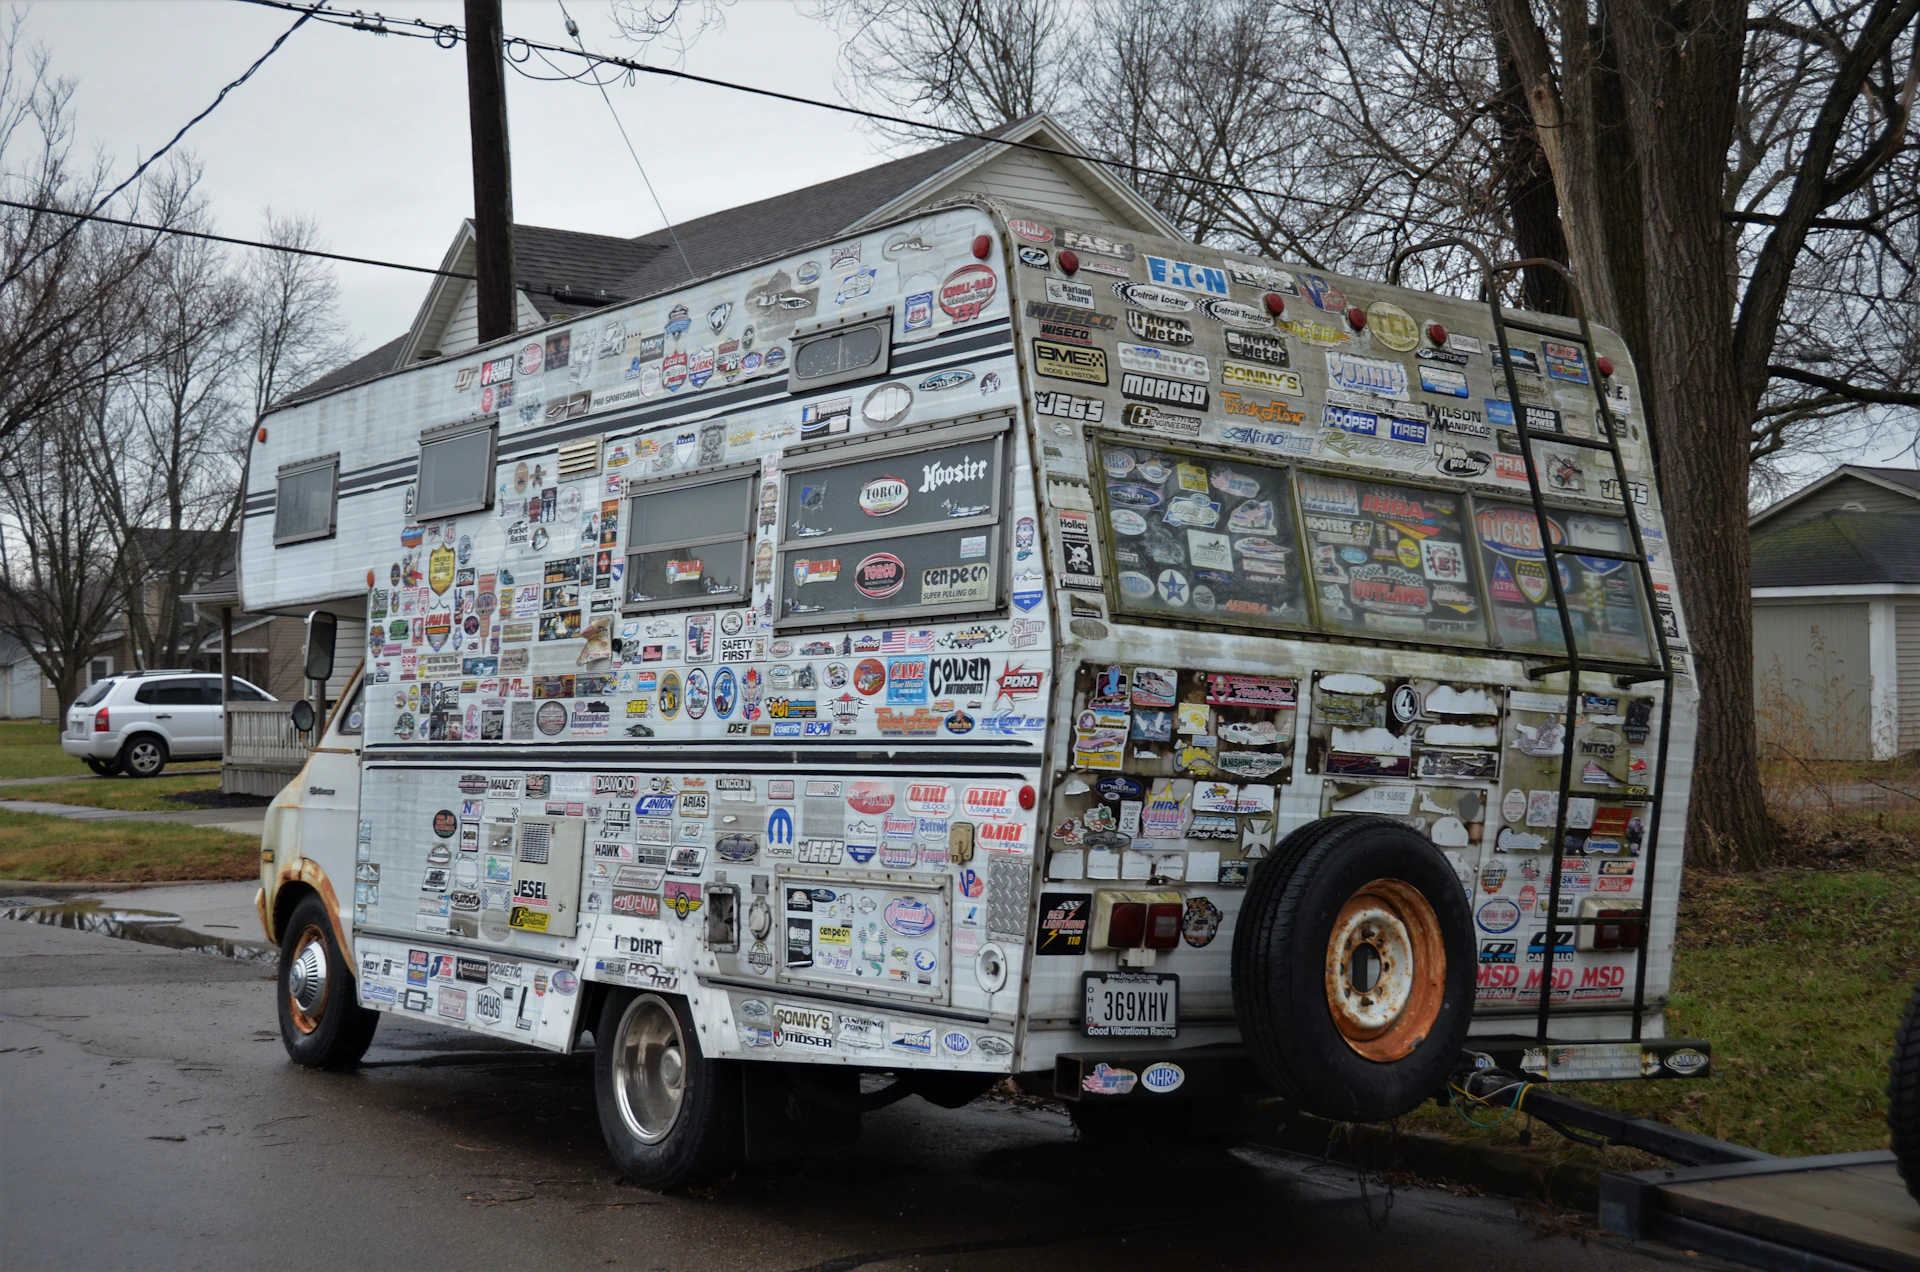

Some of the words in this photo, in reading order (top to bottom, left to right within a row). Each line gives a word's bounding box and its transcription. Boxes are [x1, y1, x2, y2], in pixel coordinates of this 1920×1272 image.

[1064, 230, 1124, 254] FAST
[1150, 257, 1228, 295] EATON
[943, 277, 994, 298] KNOLL-GAS
[1062, 284, 1092, 297] Harland
[1297, 274, 1330, 310] VP
[1066, 293, 1089, 304] Sharp
[1131, 289, 1158, 302] Detroit
[1161, 294, 1188, 307] Locker
[1031, 303, 1114, 330] WISECO
[1147, 313, 1184, 330] Auto
[1214, 305, 1239, 318] Detroit
[1241, 311, 1271, 324] Truetrac
[1042, 324, 1089, 339] WISECO
[1145, 326, 1192, 342] Meter
[1243, 334, 1278, 349] Auto
[1037, 345, 1091, 366] BME
[1243, 344, 1287, 363] Meter
[1433, 352, 1467, 364] PISTONS
[491, 358, 512, 370] SEALED
[1546, 356, 1562, 365] Blue
[1564, 359, 1584, 368] Blood
[489, 369, 511, 383] POWER
[1044, 367, 1063, 375] RODS
[1071, 371, 1100, 380] PISTONS
[1224, 366, 1298, 389] SONNY'S
[593, 396, 604, 407] PRO
[605, 387, 640, 405] SPORTSMAN
[1123, 374, 1207, 405] MOROSO
[1343, 383, 1363, 391] RACING
[1366, 387, 1397, 396] EQUIPMENT
[1038, 393, 1103, 421] JEG'S
[1220, 390, 1263, 423] Trick
[1261, 401, 1305, 425] Flow
[1385, 408, 1406, 417] RACING
[1424, 403, 1481, 423] WILSON
[1526, 408, 1555, 419] SEALED
[1149, 418, 1198, 432] ENGINEERING
[1151, 411, 1200, 424] COMPETITION
[1526, 416, 1556, 428] POWER
[1392, 422, 1425, 438] TIRES
[1434, 417, 1491, 436] MANIFOLDS
[1317, 426, 1436, 471] Racing
[919, 455, 988, 493] Hoosier
[1450, 458, 1488, 475] pro-flow
[865, 485, 902, 500] TORCO
[1325, 505, 1355, 514] RACING
[1362, 495, 1424, 519] IHRA
[508, 526, 528, 535] Bracket
[1060, 519, 1088, 532] Holley
[1483, 519, 1531, 546] LUCAS
[510, 535, 528, 544] Racing
[864, 563, 897, 580] TORCO
[1061, 574, 1102, 587] FLOWMASTER
[1493, 581, 1517, 591] ATPA
[924, 591, 941, 599] SUPER
[943, 589, 966, 598] PULLING
[1353, 579, 1427, 606] OUTLAWS
[1225, 599, 1267, 616] AHDRA
[1011, 618, 1045, 634] Show
[722, 639, 753, 650] SAFETY
[1008, 633, 1037, 649] Time
[722, 650, 751, 661] FIRST
[890, 661, 925, 680] CAM2
[905, 680, 923, 688] Blood
[944, 683, 984, 695] MOTORSPORTS
[1002, 676, 1038, 688] PDRA
[832, 701, 859, 716] OUTLAW
[775, 723, 800, 733] COMETIC
[1582, 742, 1615, 754] NITRO
[1221, 757, 1253, 768] VANISHING
[490, 779, 517, 790] MANLEY
[597, 776, 635, 791] DIAMOND
[718, 779, 750, 789] LINCOLN
[910, 785, 950, 803] DART
[968, 789, 1011, 807] DART
[683, 796, 706, 808] ARIAS
[1152, 801, 1179, 811] IHRA
[970, 806, 1012, 815] MANIFOLDS
[883, 814, 916, 834] SUMMIT
[919, 818, 947, 833] Detroit
[1122, 818, 1134, 830] 35
[981, 823, 1027, 841] DART
[1188, 830, 1211, 839] Drag
[1212, 832, 1239, 842] Racing
[595, 844, 620, 857] HAWK
[768, 848, 792, 856] MOPAR
[800, 840, 844, 865] JEG'S
[514, 880, 548, 900] JESEL
[960, 870, 975, 897] VP
[614, 894, 658, 915] PHOENIX
[892, 899, 928, 925] SUMMIT
[1047, 910, 1065, 919] RED
[1042, 919, 1086, 929] LIGHTNING
[615, 935, 619, 949] I
[630, 937, 663, 955] DIRT
[1067, 936, 1081, 945] 110
[363, 960, 379, 970] INDY
[1526, 953, 1573, 962] CAILLO
[463, 962, 487, 972] ALLSTAR
[491, 961, 521, 978] COMETIC
[628, 962, 658, 978] PRO
[463, 971, 487, 979] PERFORMANCE
[649, 975, 678, 990] TRU
[1477, 965, 1520, 987] MSD
[1524, 968, 1574, 989] MSD
[1581, 966, 1625, 987] MSD
[372, 985, 396, 995] prestolite
[1574, 988, 1621, 998] DISTRIBUTOR
[1104, 991, 1168, 1022] 369XHV
[777, 1009, 830, 1031] SONNY'S
[838, 1015, 884, 1028] VANISHING
[845, 1024, 868, 1033] POINT
[1087, 1026, 1109, 1035] Good
[1110, 1026, 1149, 1036] Vibrations
[1150, 1027, 1176, 1037] Racing
[785, 1032, 832, 1048] MOSER
[904, 1033, 931, 1047] NSCA
[945, 1035, 970, 1050] NHRA
[1149, 1071, 1178, 1086] NHRA
